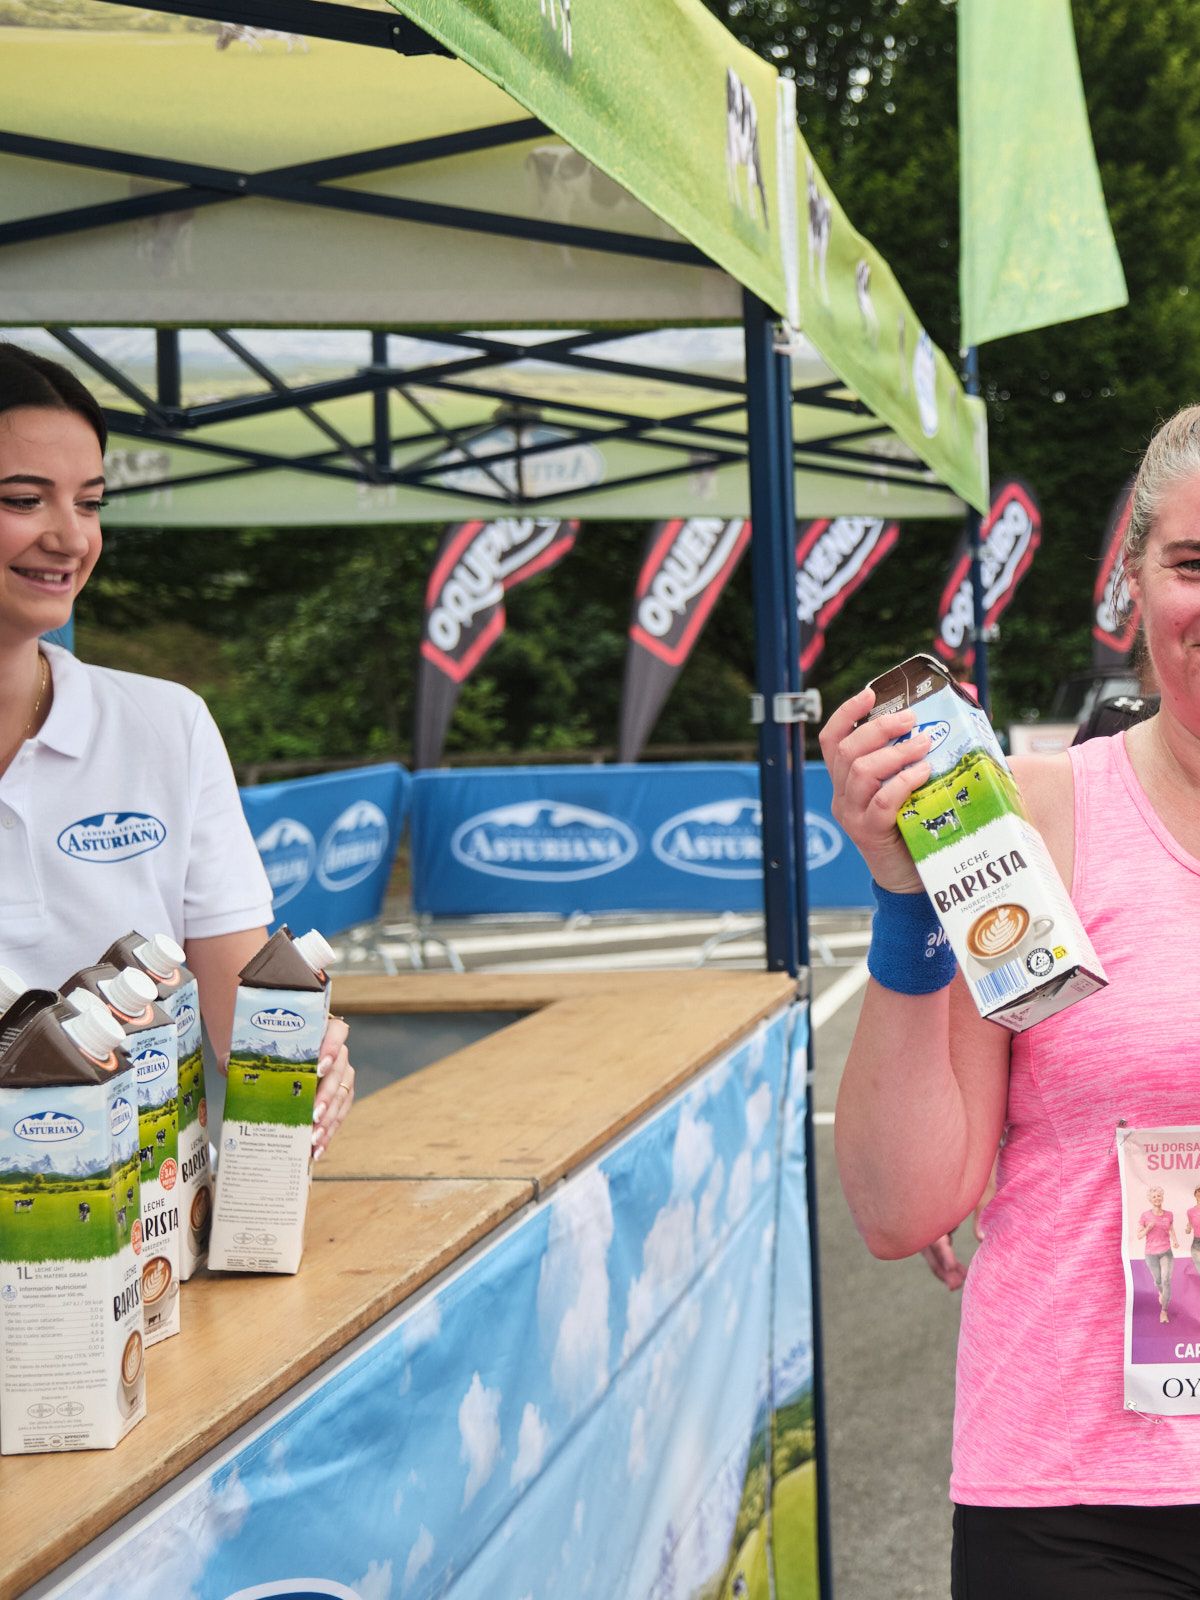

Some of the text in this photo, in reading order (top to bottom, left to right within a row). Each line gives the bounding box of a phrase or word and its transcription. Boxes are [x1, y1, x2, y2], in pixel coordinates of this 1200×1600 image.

[638, 518, 725, 637] OQUEN
[68, 830, 159, 852] ASTURIANA
[466, 828, 623, 862] ASTURIANA
[667, 827, 827, 860] ASTURA
[954, 850, 989, 874] LECHE
[934, 850, 1027, 913] BARISTA
[254, 1015, 301, 1028] ASTURIANA
[20, 1124, 79, 1135] ASTURIANA
[239, 1126, 251, 1136] 1L
[1144, 1144, 1159, 1153] TU
[144, 1198, 165, 1212] LECHE
[142, 1208, 178, 1242] RISTA
[17, 1266, 33, 1280] 1L
